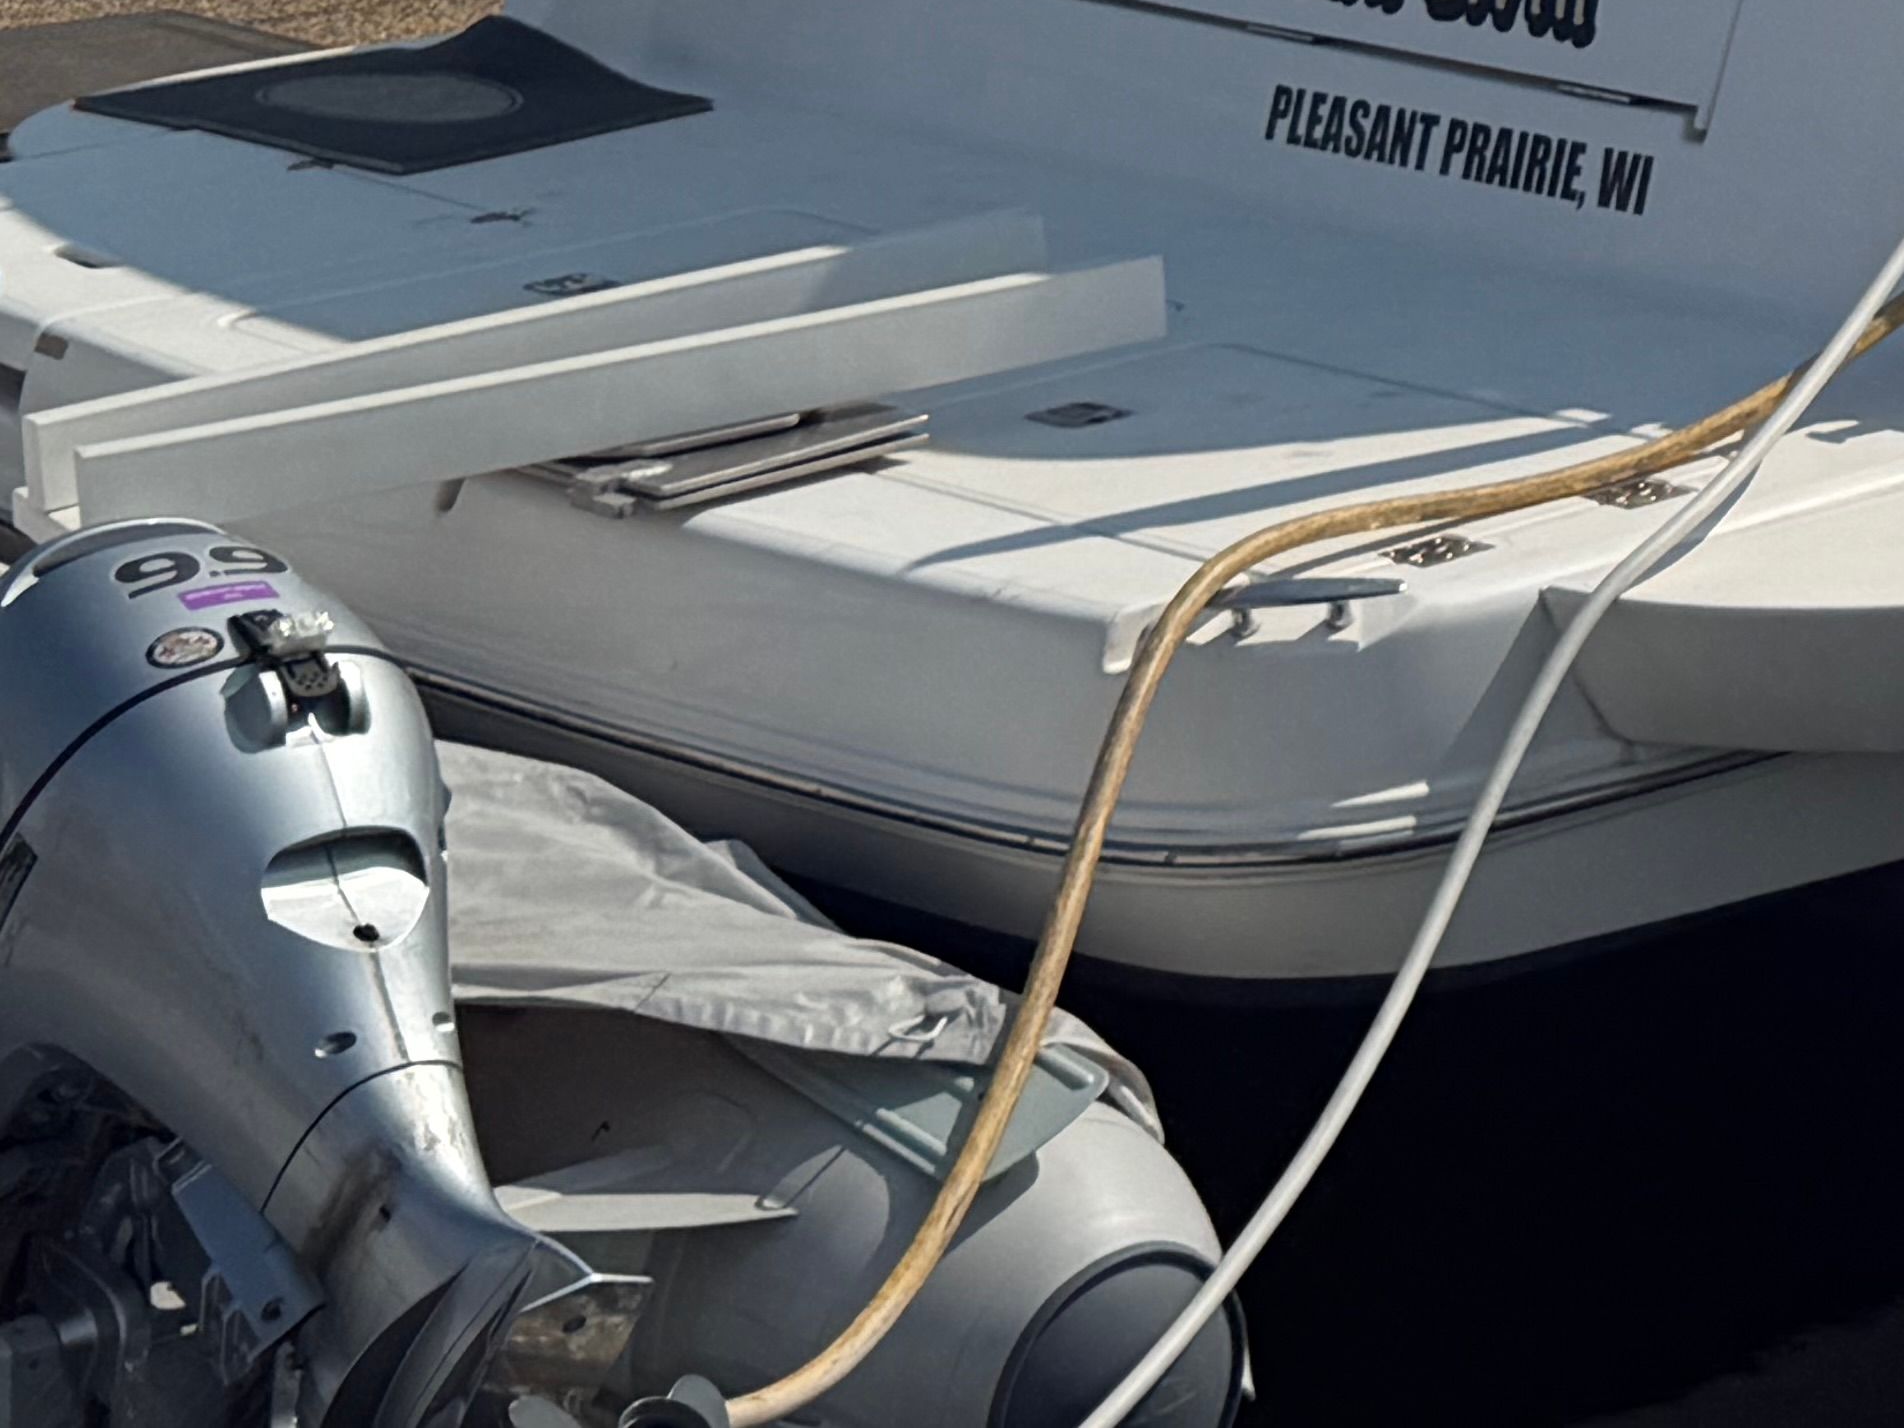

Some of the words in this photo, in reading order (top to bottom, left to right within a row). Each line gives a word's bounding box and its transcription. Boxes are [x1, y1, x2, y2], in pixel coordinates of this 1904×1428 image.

[1264, 84, 1440, 172] PLEASANT
[1439, 118, 1588, 210] PRAIRIE,
[1597, 147, 1654, 216] WI
